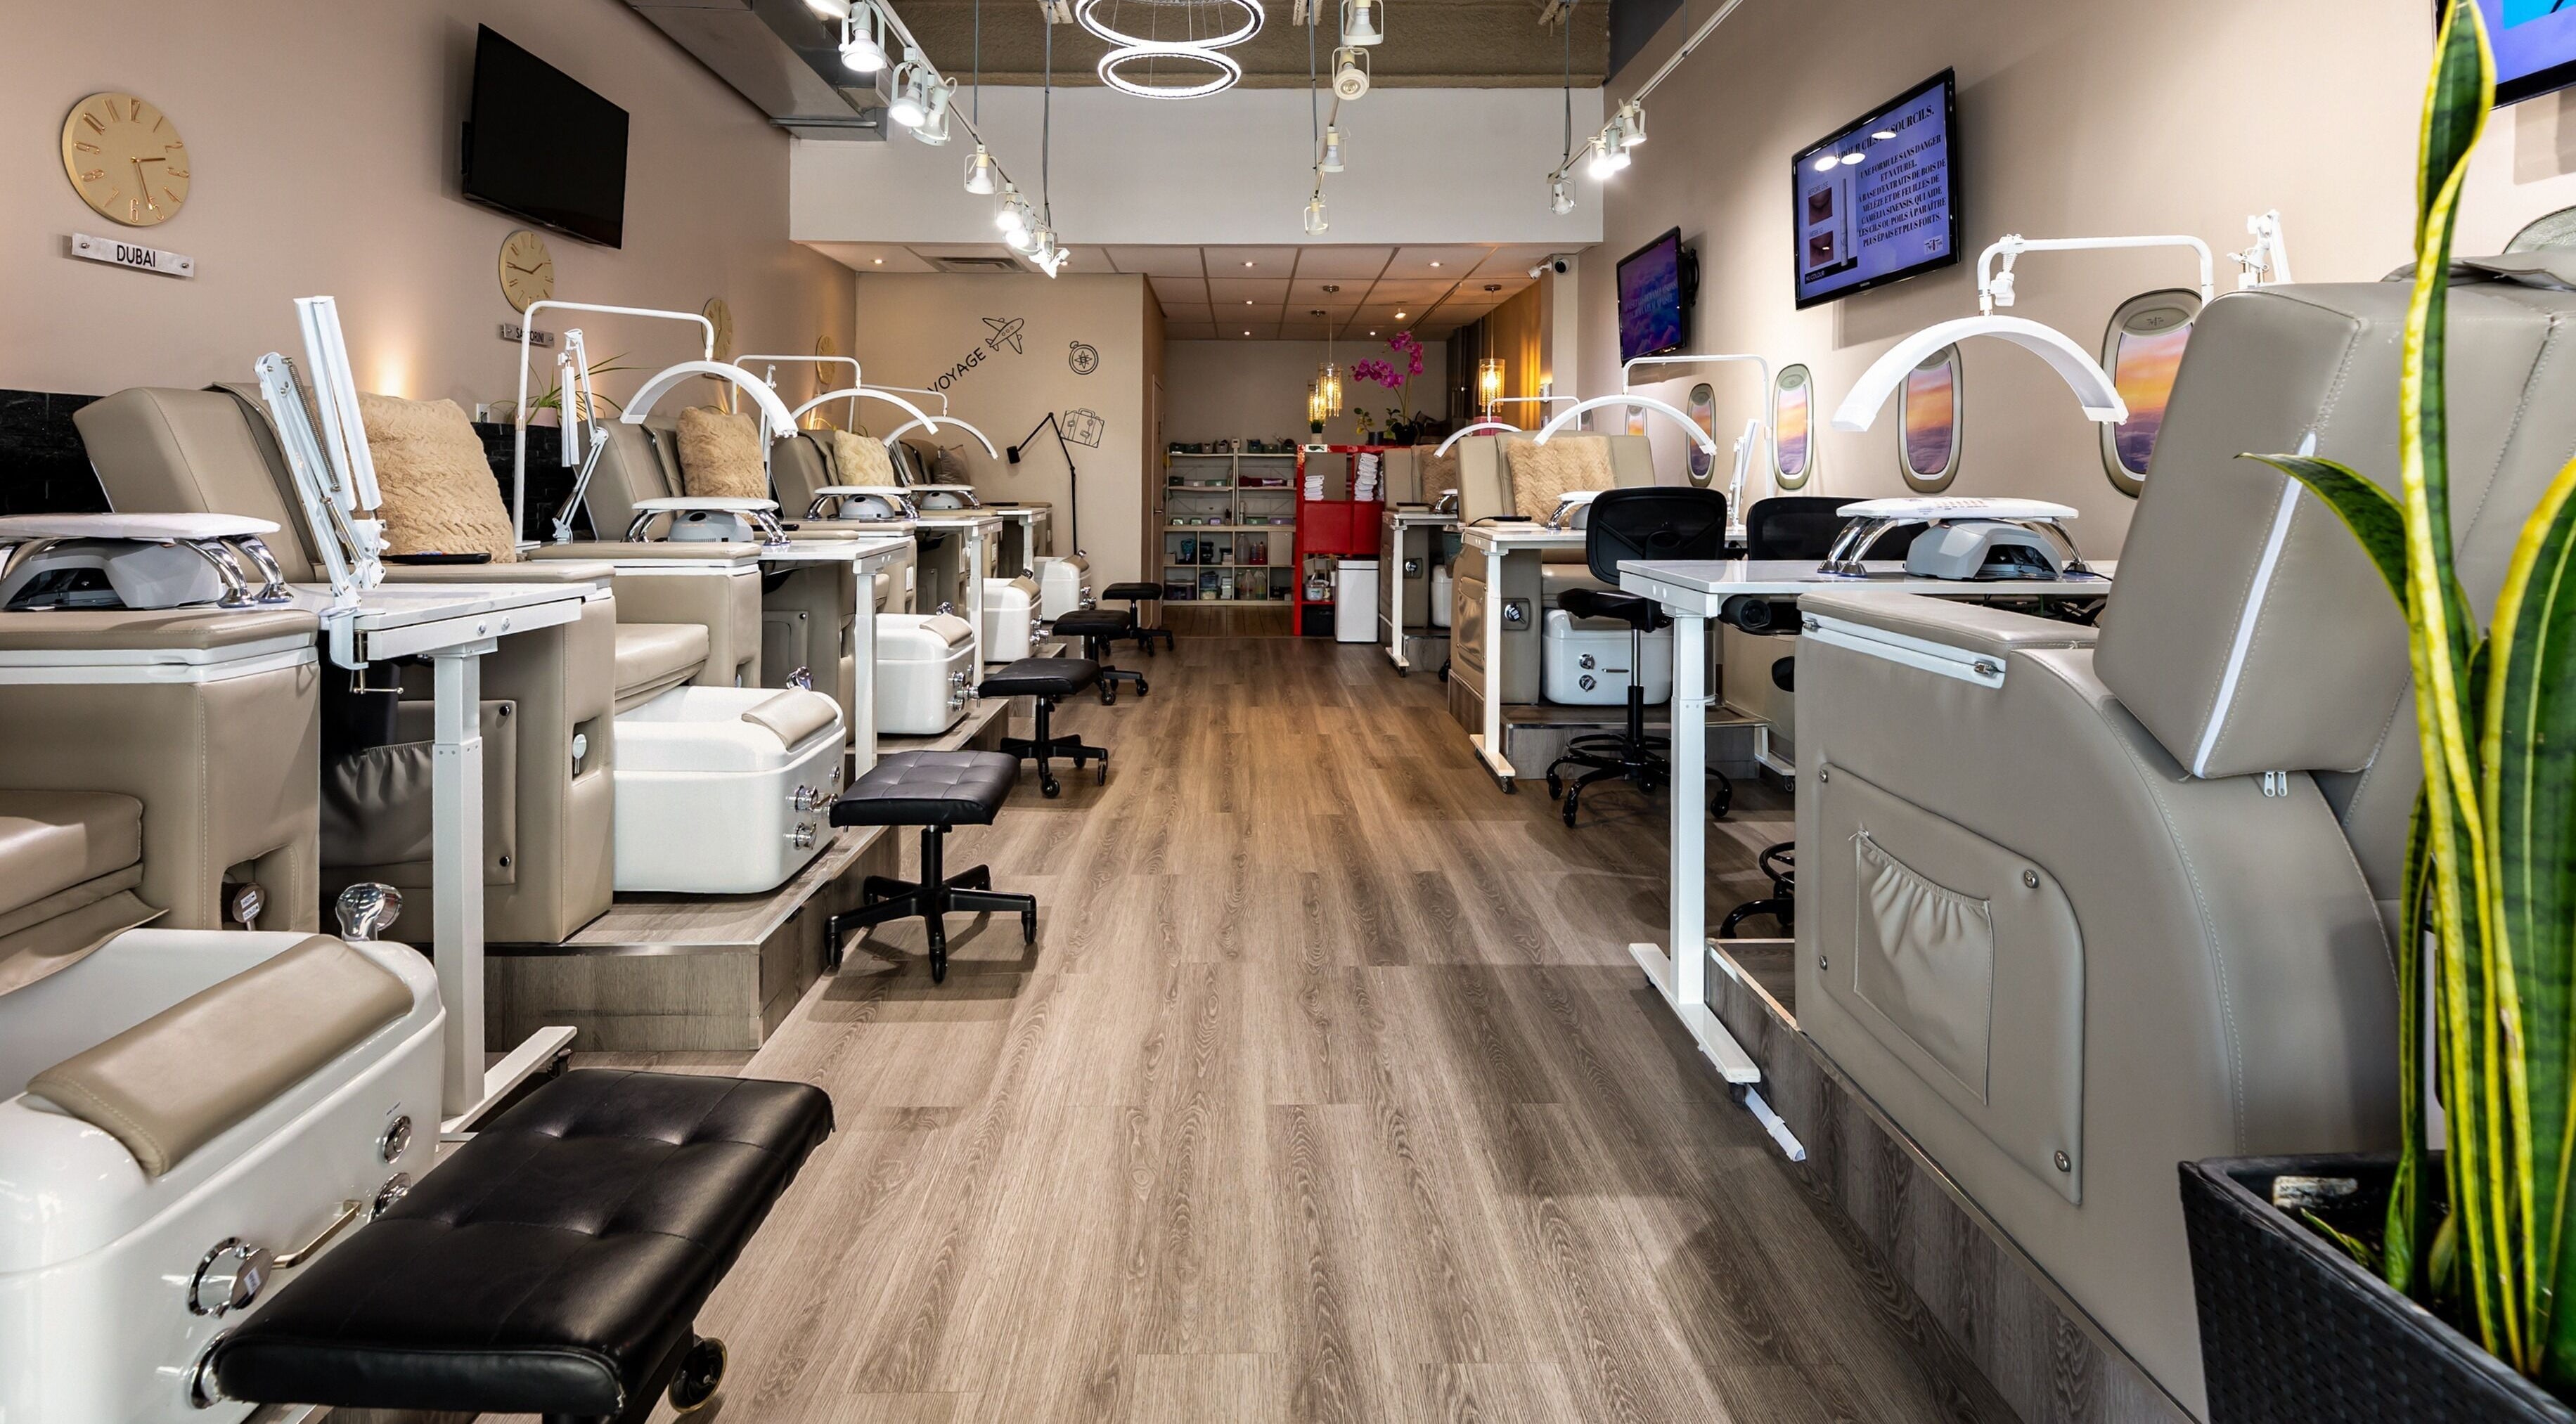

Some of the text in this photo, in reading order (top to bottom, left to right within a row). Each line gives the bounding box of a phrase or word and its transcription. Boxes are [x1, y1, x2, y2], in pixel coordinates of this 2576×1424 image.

[130, 98, 141, 124] 12
[1891, 103, 1934, 132] SOURCILS.
[1872, 154, 1898, 174] FORMULE
[1899, 147, 1914, 161] SANS
[1915, 134, 1941, 153] DANGER
[1862, 188, 1876, 202] BASE
[1912, 169, 1921, 180] DE
[1921, 162, 1936, 176] BOIS
[1937, 157, 1946, 169] DE
[1880, 171, 1888, 182] ET
[1884, 193, 1892, 204] ET
[1893, 190, 1900, 200] DE
[1901, 177, 1930, 197] FEUILLES
[1931, 173, 1940, 185] DE
[1914, 192, 1926, 205] QUI
[1927, 186, 1942, 198] AIDE
[130, 198, 139, 223] 6
[1858, 227, 1869, 238] LES
[1869, 221, 1881, 233] CILS
[1881, 219, 1890, 228] OU
[1891, 212, 1908, 226] POILS
[1862, 212, 1942, 247] PLUS ÉPAIS ET PLUS FORTS.
[117, 244, 155, 267] DUBAI
[516, 327, 544, 343] SAORINI
[927, 347, 986, 391] VOYAGE
